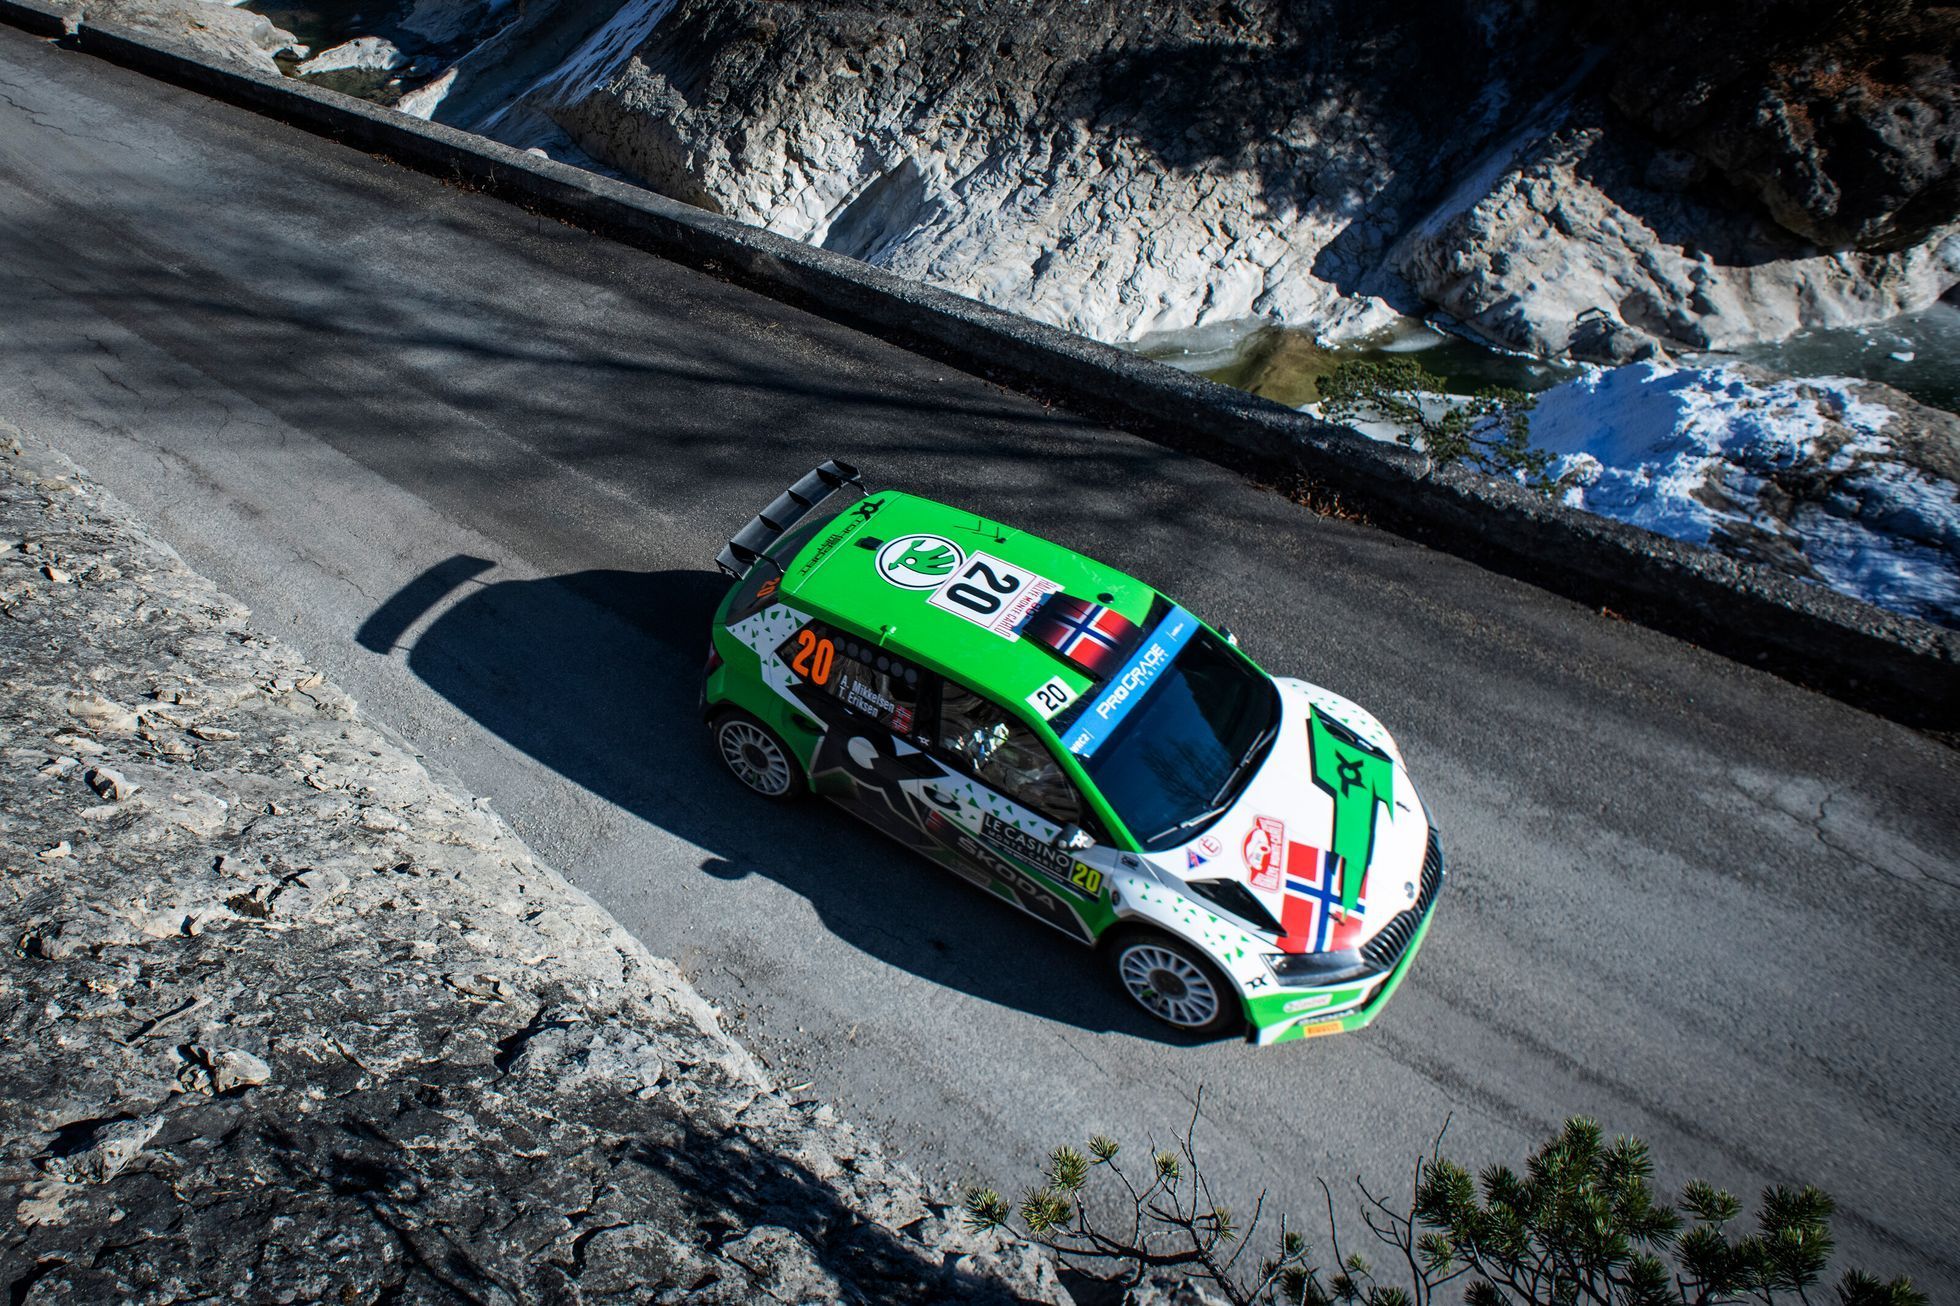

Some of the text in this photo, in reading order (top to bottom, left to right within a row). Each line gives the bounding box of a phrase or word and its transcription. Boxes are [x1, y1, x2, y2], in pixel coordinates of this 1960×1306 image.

[946, 561, 1020, 614] 20
[792, 630, 834, 685] 20
[1139, 652, 1169, 686] DIGITAL
[840, 675, 894, 714] A. Mikkelsen
[840, 685, 878, 718] T. Eriksen
[1037, 683, 1068, 712] 20
[984, 814, 1002, 831] LE
[1004, 827, 1069, 868] CASINO
[958, 835, 1056, 912] ŠKODA
[1072, 864, 1101, 894] 20
